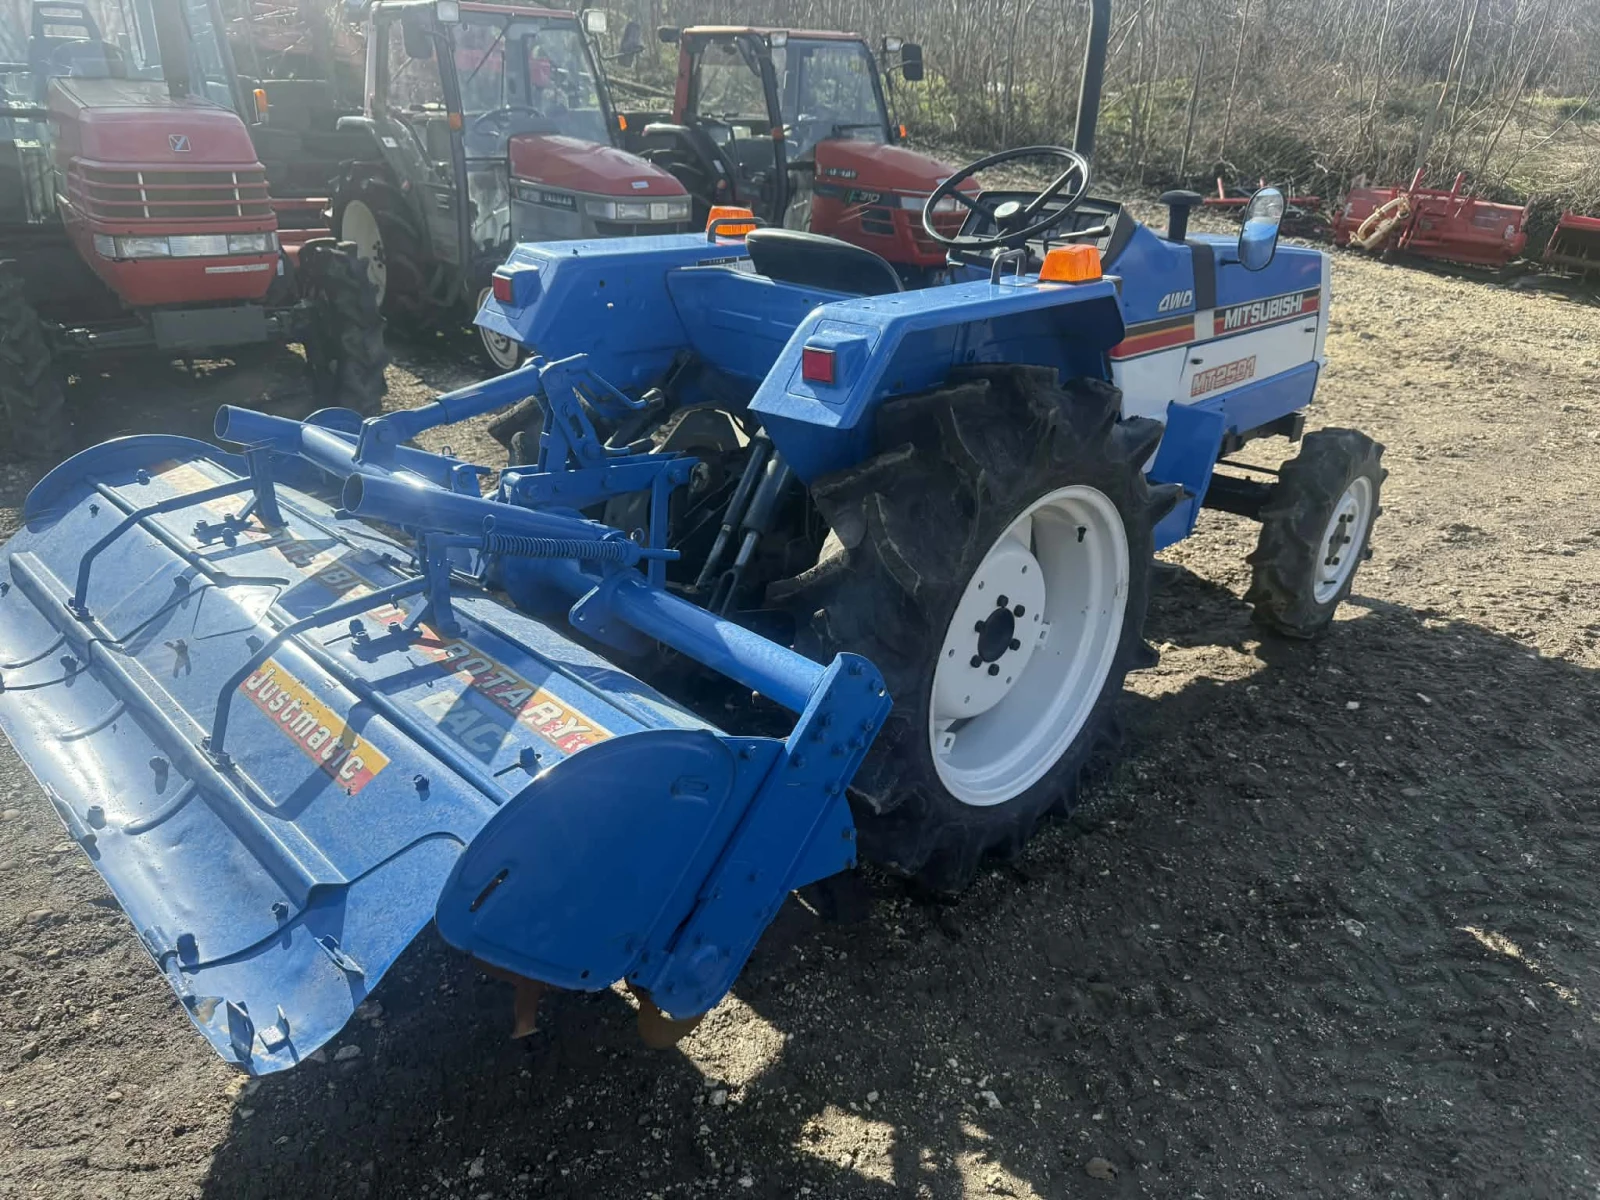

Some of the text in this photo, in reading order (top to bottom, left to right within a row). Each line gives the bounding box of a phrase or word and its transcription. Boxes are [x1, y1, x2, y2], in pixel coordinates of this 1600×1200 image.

[1158, 290, 1193, 312] 4WD
[1224, 294, 1303, 330] MITSUBISHI
[435, 643, 592, 739] ROTARY
[246, 668, 364, 781] Justmatic
